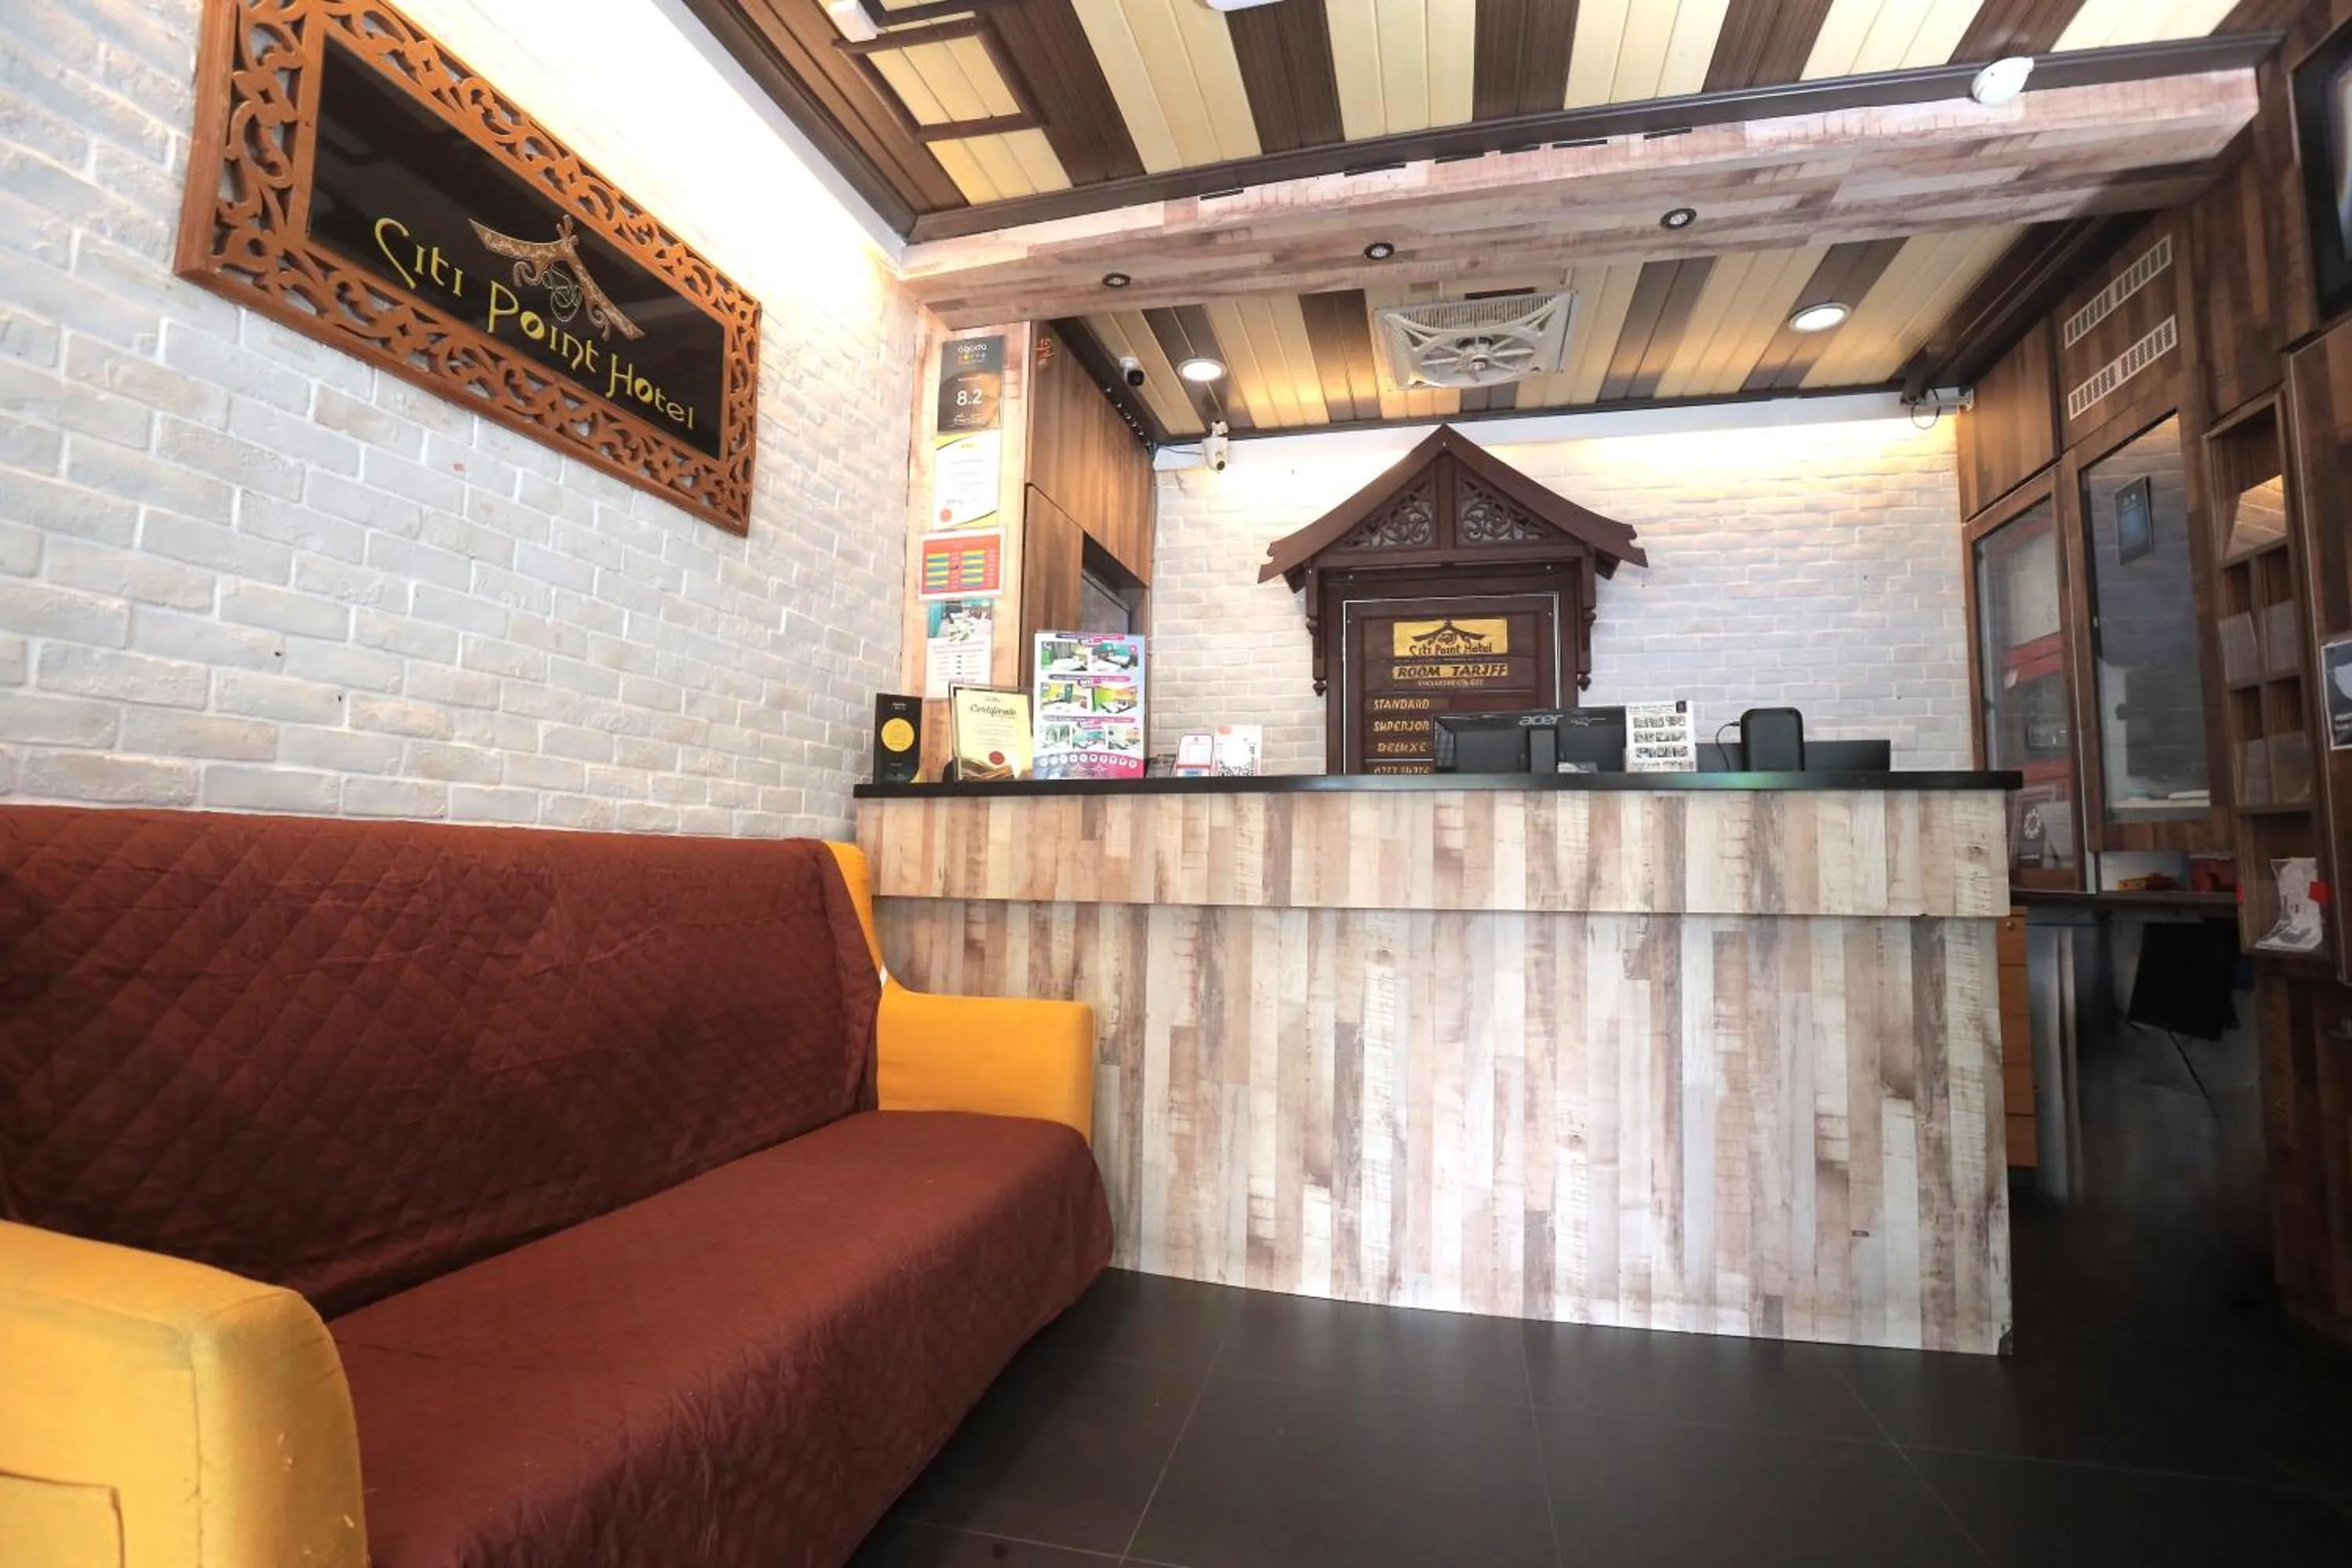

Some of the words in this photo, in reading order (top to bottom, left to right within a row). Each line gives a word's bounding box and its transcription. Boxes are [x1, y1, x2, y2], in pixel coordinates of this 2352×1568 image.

[374, 217, 463, 298] Citi
[487, 281, 598, 372] Point
[606, 353, 695, 429] Hotel
[956, 389, 982, 405] 8.2
[1409, 644, 1432, 656] Citi
[1436, 643, 1461, 655] Point
[1464, 641, 1492, 654] Hotel
[1398, 666, 1441, 677] ROOM
[1452, 664, 1506, 675] TARIFF
[1374, 699, 1429, 710] STANDARD
[1374, 720, 1429, 731] SUPERIOR
[1519, 714, 1563, 725] acer
[1377, 742, 1427, 753] DELUXE
